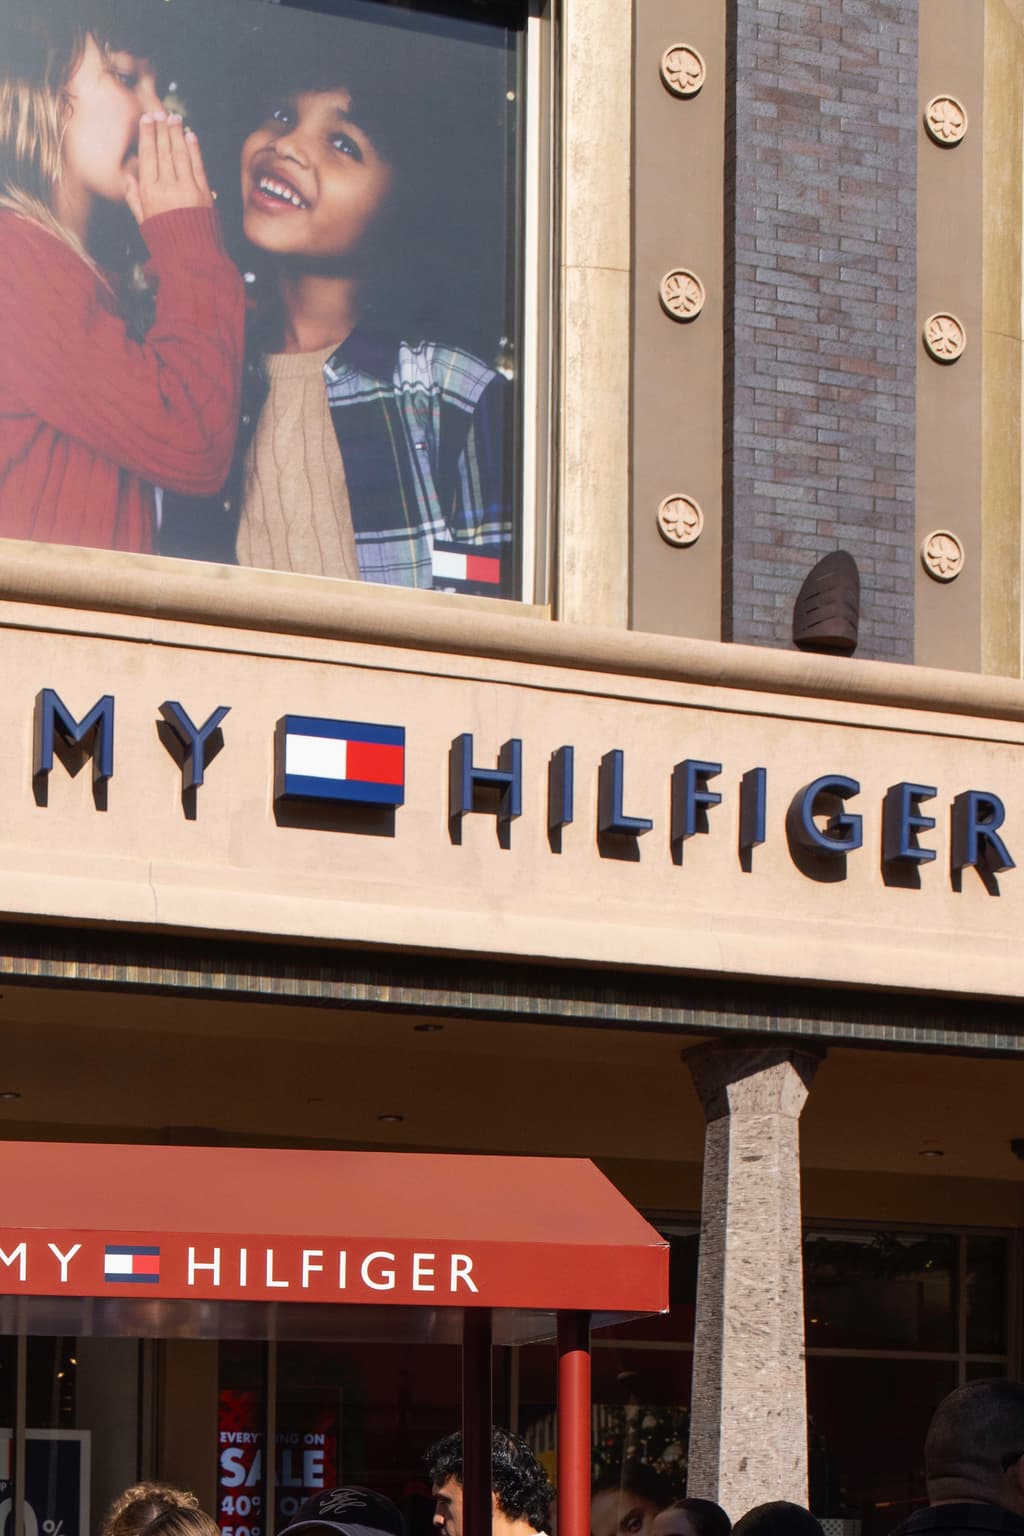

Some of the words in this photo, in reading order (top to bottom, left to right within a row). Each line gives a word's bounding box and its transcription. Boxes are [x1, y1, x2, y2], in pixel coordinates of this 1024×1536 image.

[450, 733, 1017, 875] HILFIGER
[187, 1246, 480, 1294] HILFIGER
[303, 1433, 325, 1445] ON
